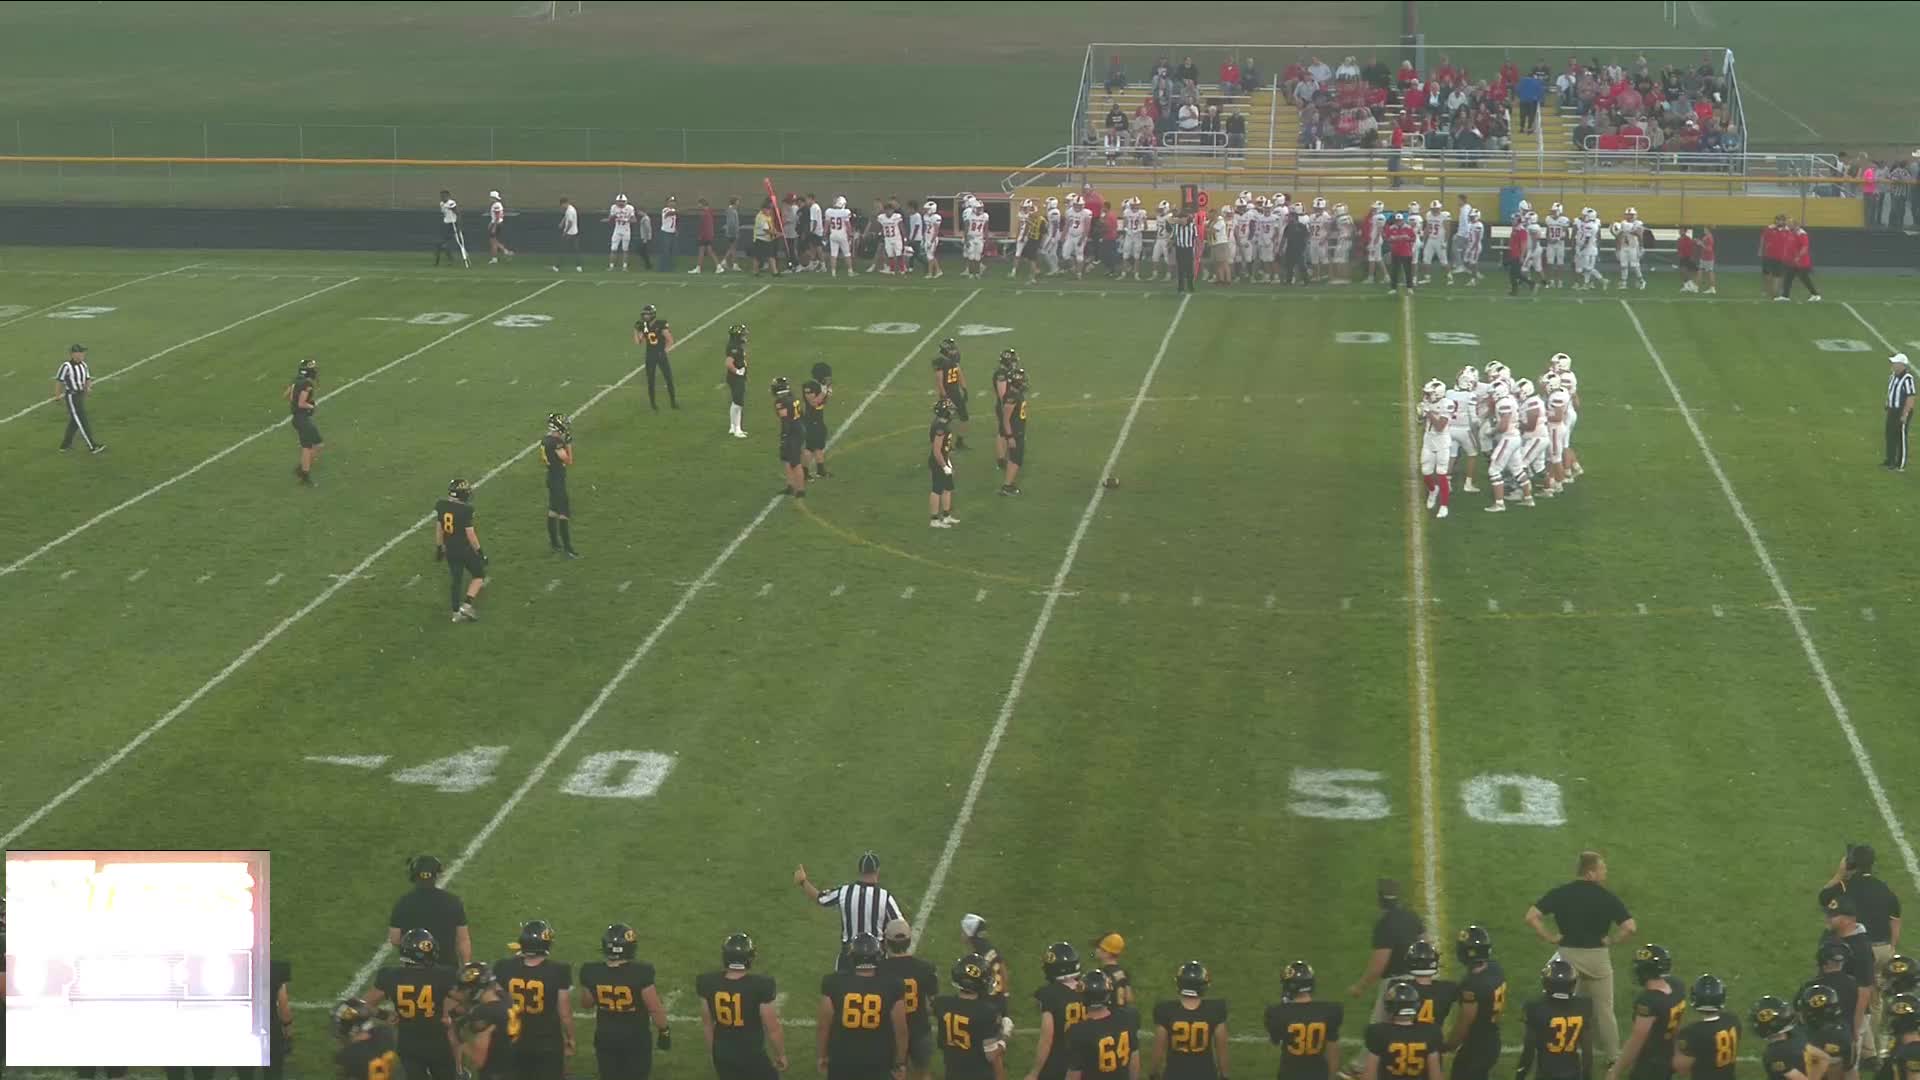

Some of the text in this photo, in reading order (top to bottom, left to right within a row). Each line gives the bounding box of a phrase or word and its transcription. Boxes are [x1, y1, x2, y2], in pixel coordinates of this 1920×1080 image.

[443, 512, 454, 535] 8
[396, 984, 434, 1018] 54
[596, 984, 635, 1012] 52
[714, 991, 744, 1026] 61
[842, 992, 882, 1030] 68
[943, 1012, 972, 1050] 15
[1171, 1021, 1209, 1053] 20
[1287, 1023, 1326, 1056] 30
[1547, 1016, 1583, 1053] 37
[1716, 1026, 1738, 1068] 81
[1098, 1030, 1131, 1073] 64
[1386, 1042, 1427, 1076] 35
